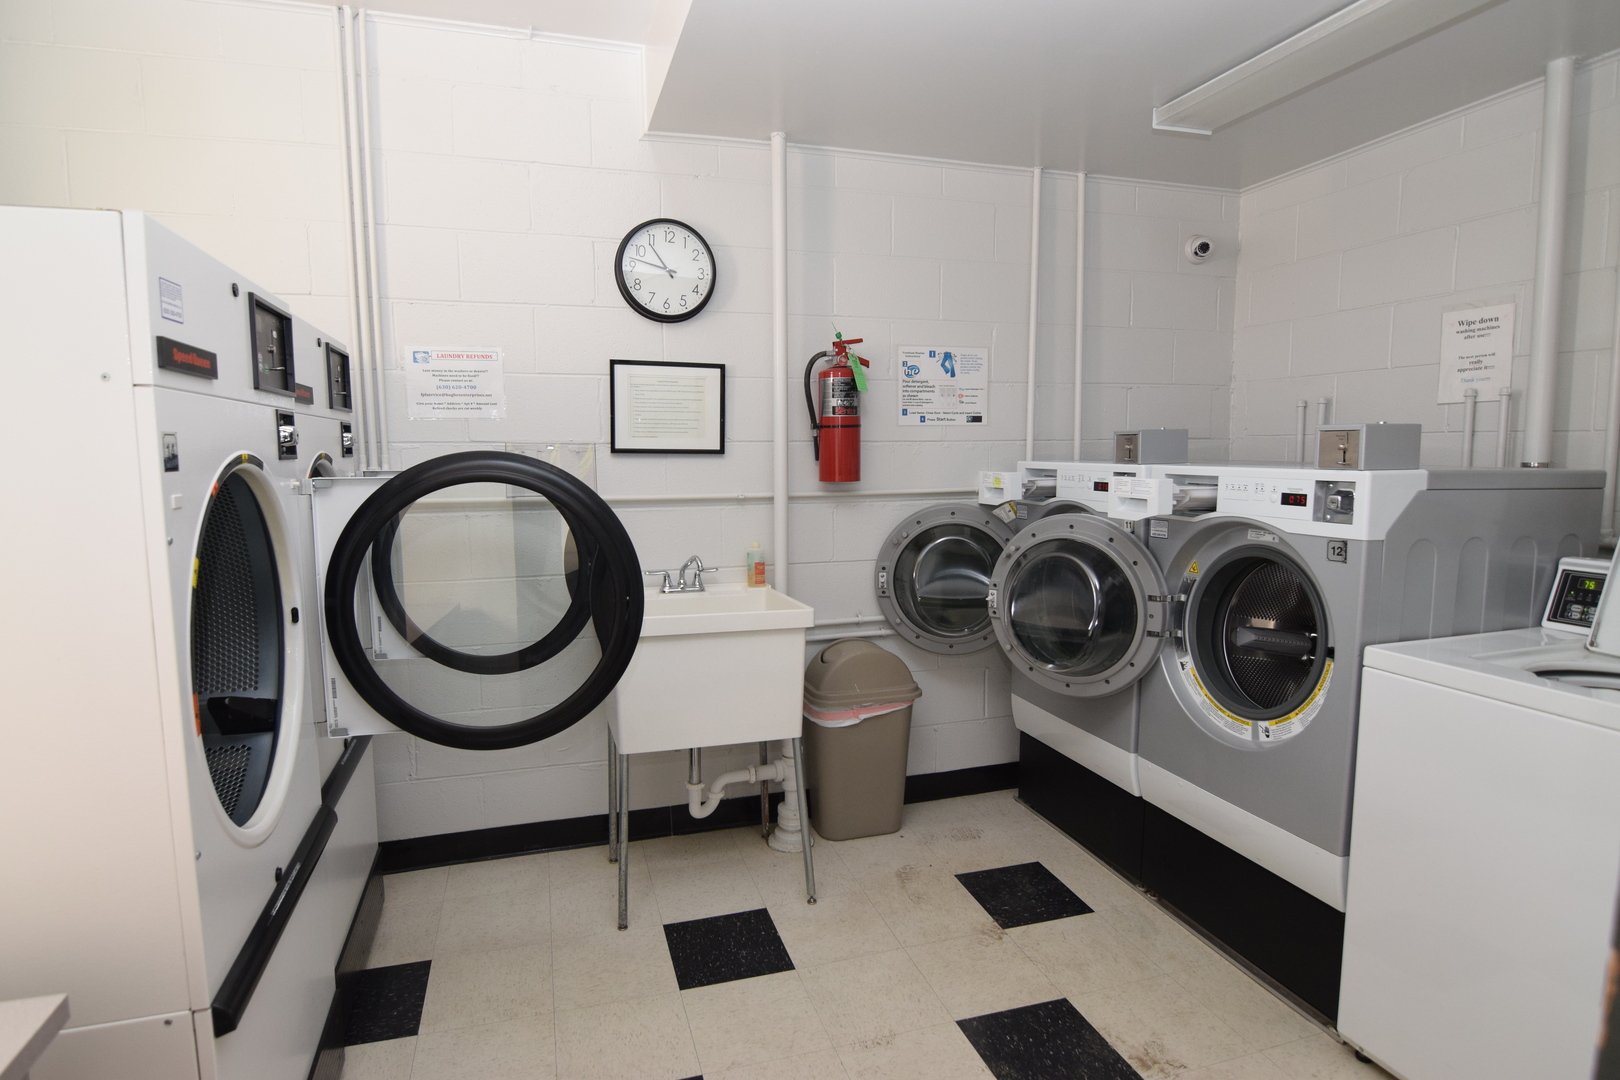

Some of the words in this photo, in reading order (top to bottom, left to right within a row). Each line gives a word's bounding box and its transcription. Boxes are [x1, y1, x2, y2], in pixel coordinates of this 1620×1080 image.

[648, 234, 655, 246] 11
[664, 231, 676, 243] 12
[683, 237, 687, 249] 1
[635, 245, 646, 257] 10
[692, 249, 700, 261] 2
[629, 260, 636, 272] 9
[697, 268, 705, 280] 3
[633, 278, 642, 291] 8
[692, 284, 699, 295] 4
[648, 292, 655, 304] 7
[663, 298, 670, 310] 6
[679, 295, 687, 307] 5
[1478, 316, 1499, 325] down
[172, 347, 193, 364] Speed
[1331, 546, 1343, 556] 12
[1584, 580, 1596, 590] 75
